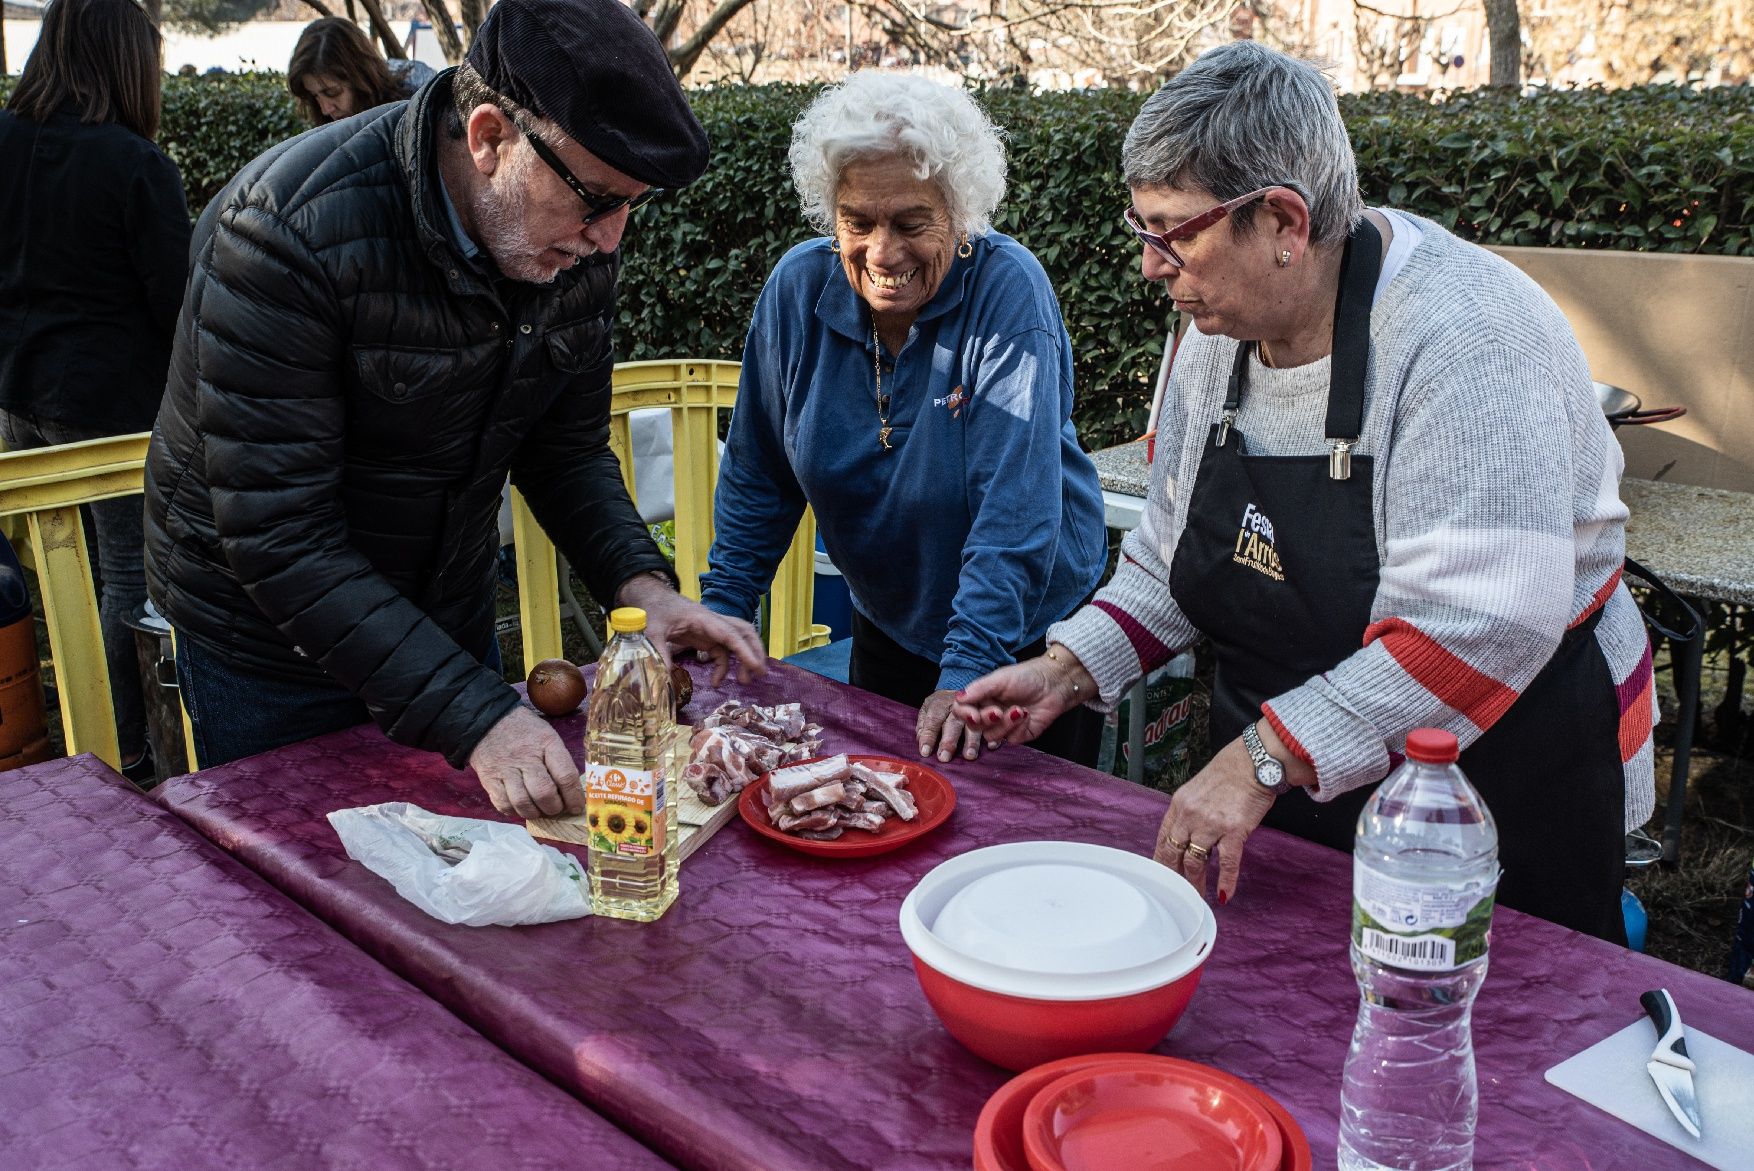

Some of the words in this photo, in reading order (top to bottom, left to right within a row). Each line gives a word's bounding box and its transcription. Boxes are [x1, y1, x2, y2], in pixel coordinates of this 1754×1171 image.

[588, 792, 607, 800] ACEITE
[607, 793, 636, 804] REFINADO
[636, 798, 645, 806] DE
